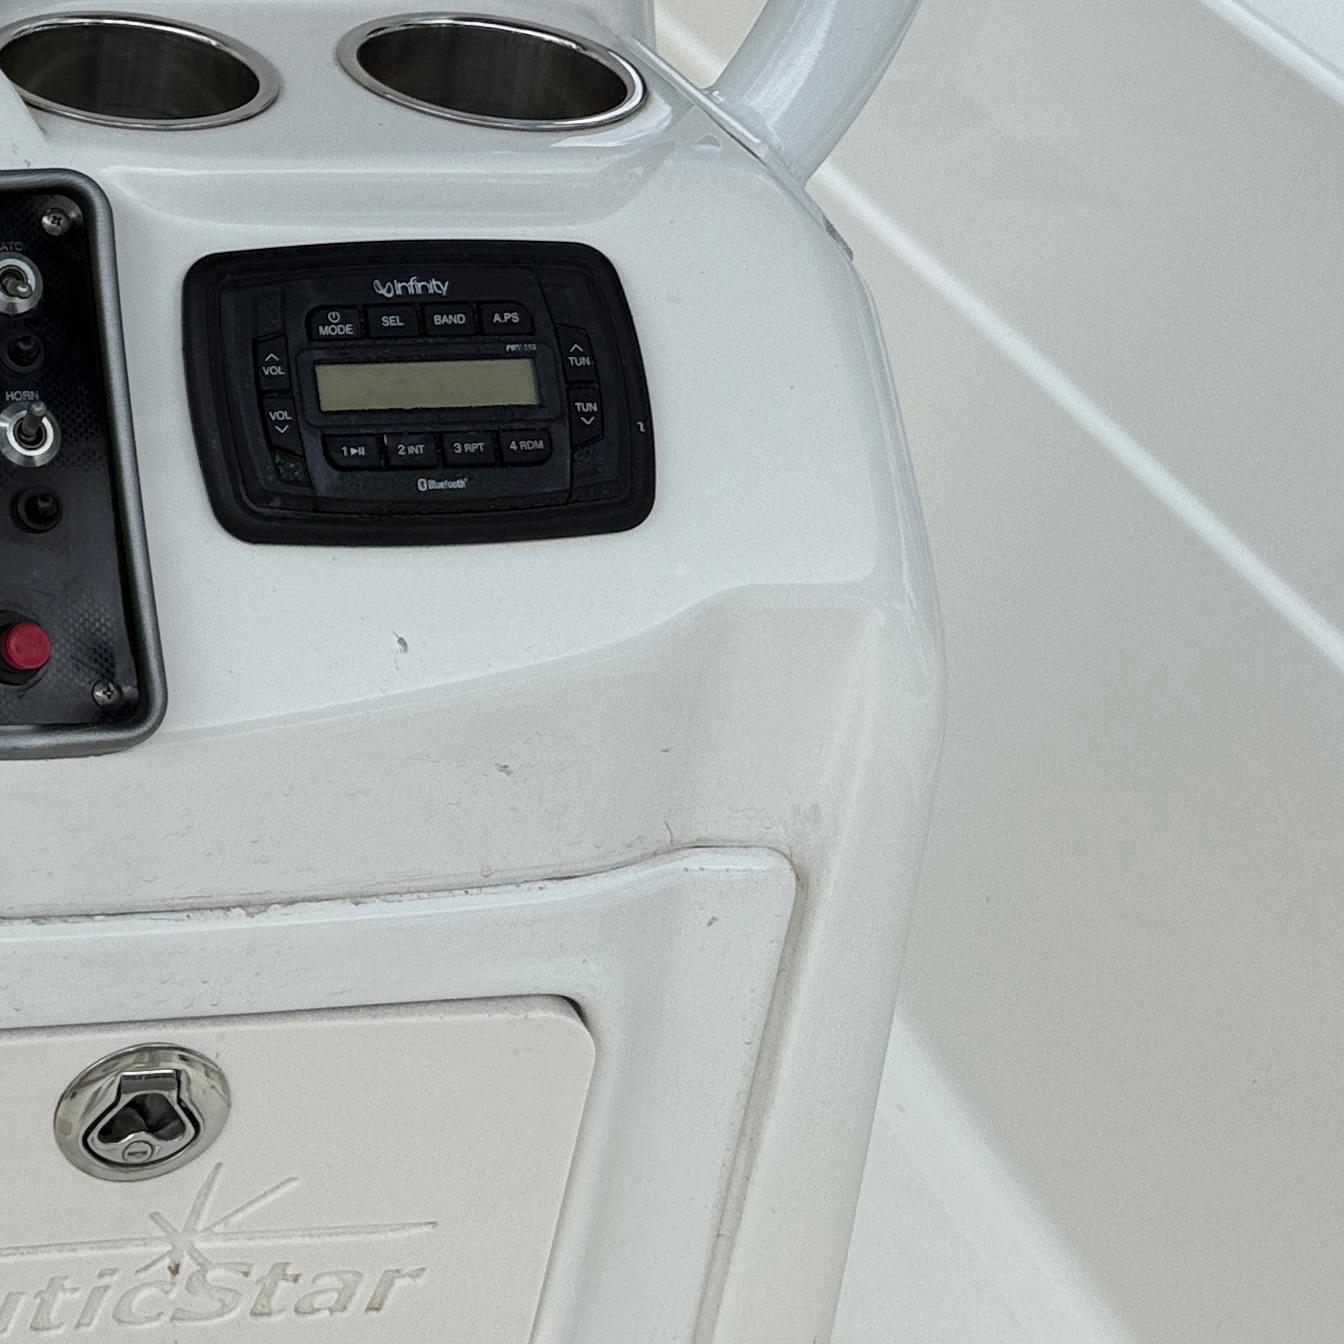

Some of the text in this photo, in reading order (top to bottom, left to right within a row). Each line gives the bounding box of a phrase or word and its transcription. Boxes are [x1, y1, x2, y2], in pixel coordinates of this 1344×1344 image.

[381, 315, 404, 327] SEL
[433, 313, 466, 326] BAND
[319, 323, 354, 336] MODE
[568, 356, 591, 367] TUN
[263, 365, 286, 376] VOL
[5, 390, 40, 402] HORN
[575, 402, 597, 413] TUN
[269, 410, 292, 421] VOL
[397, 444, 425, 456] 2 INT
[454, 441, 485, 453] 3 RPT
[509, 440, 518, 451] 4
